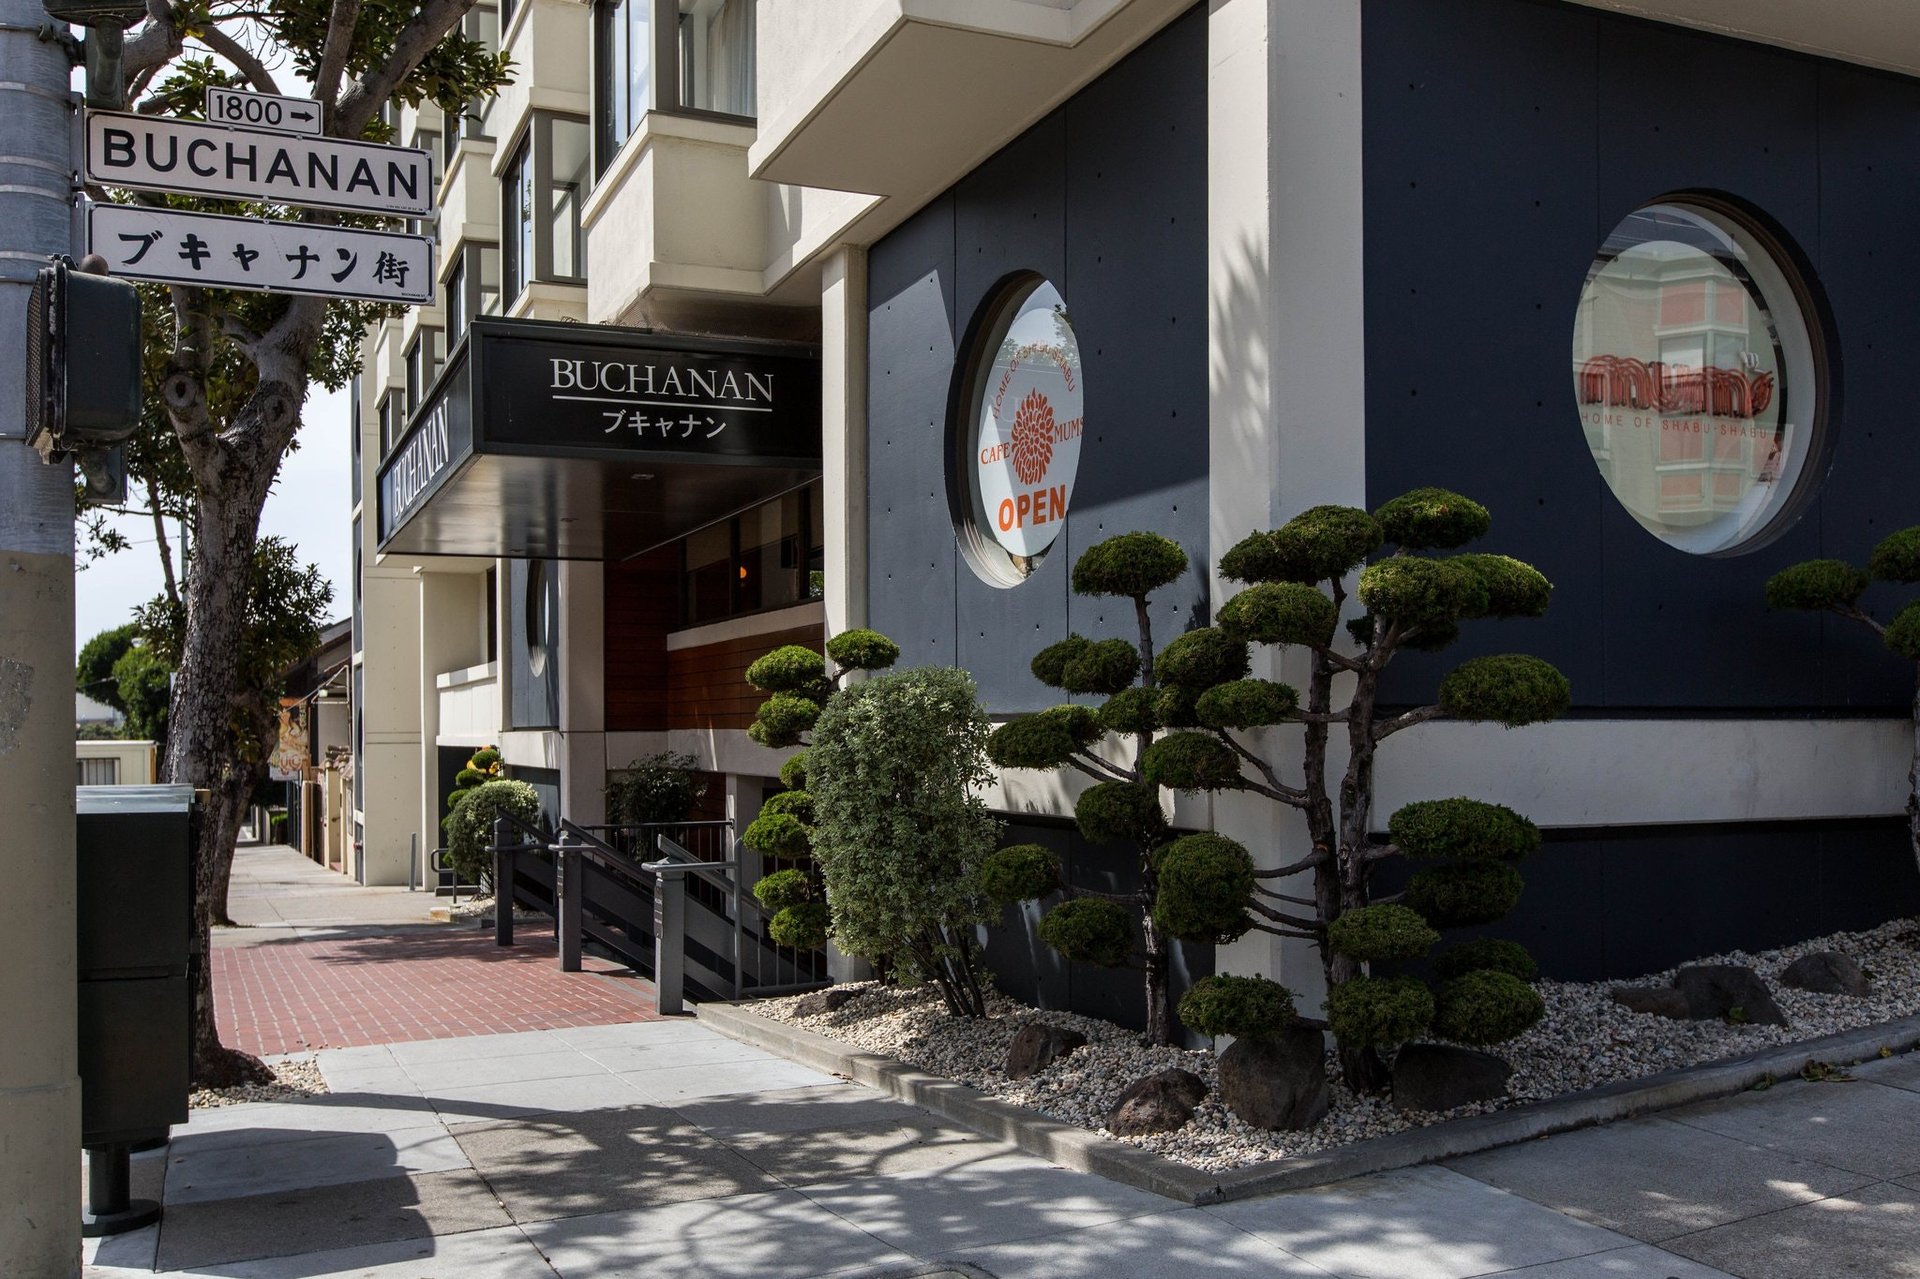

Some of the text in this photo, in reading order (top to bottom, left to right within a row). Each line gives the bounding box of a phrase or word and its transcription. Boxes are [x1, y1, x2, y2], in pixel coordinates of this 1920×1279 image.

[216, 95, 282, 126] 1800
[103, 127, 418, 200] BUCHANAN
[118, 230, 410, 288] ブキャナン街
[549, 358, 774, 402] BUCHANAN
[993, 370, 1011, 419] HOME
[602, 409, 727, 439] ブキャナン
[1582, 413, 1623, 426] HOME
[1634, 416, 1652, 428] OF
[394, 396, 449, 518] BUCHANAN
[980, 442, 1011, 465] CAFE
[998, 484, 1066, 532] OPEN
